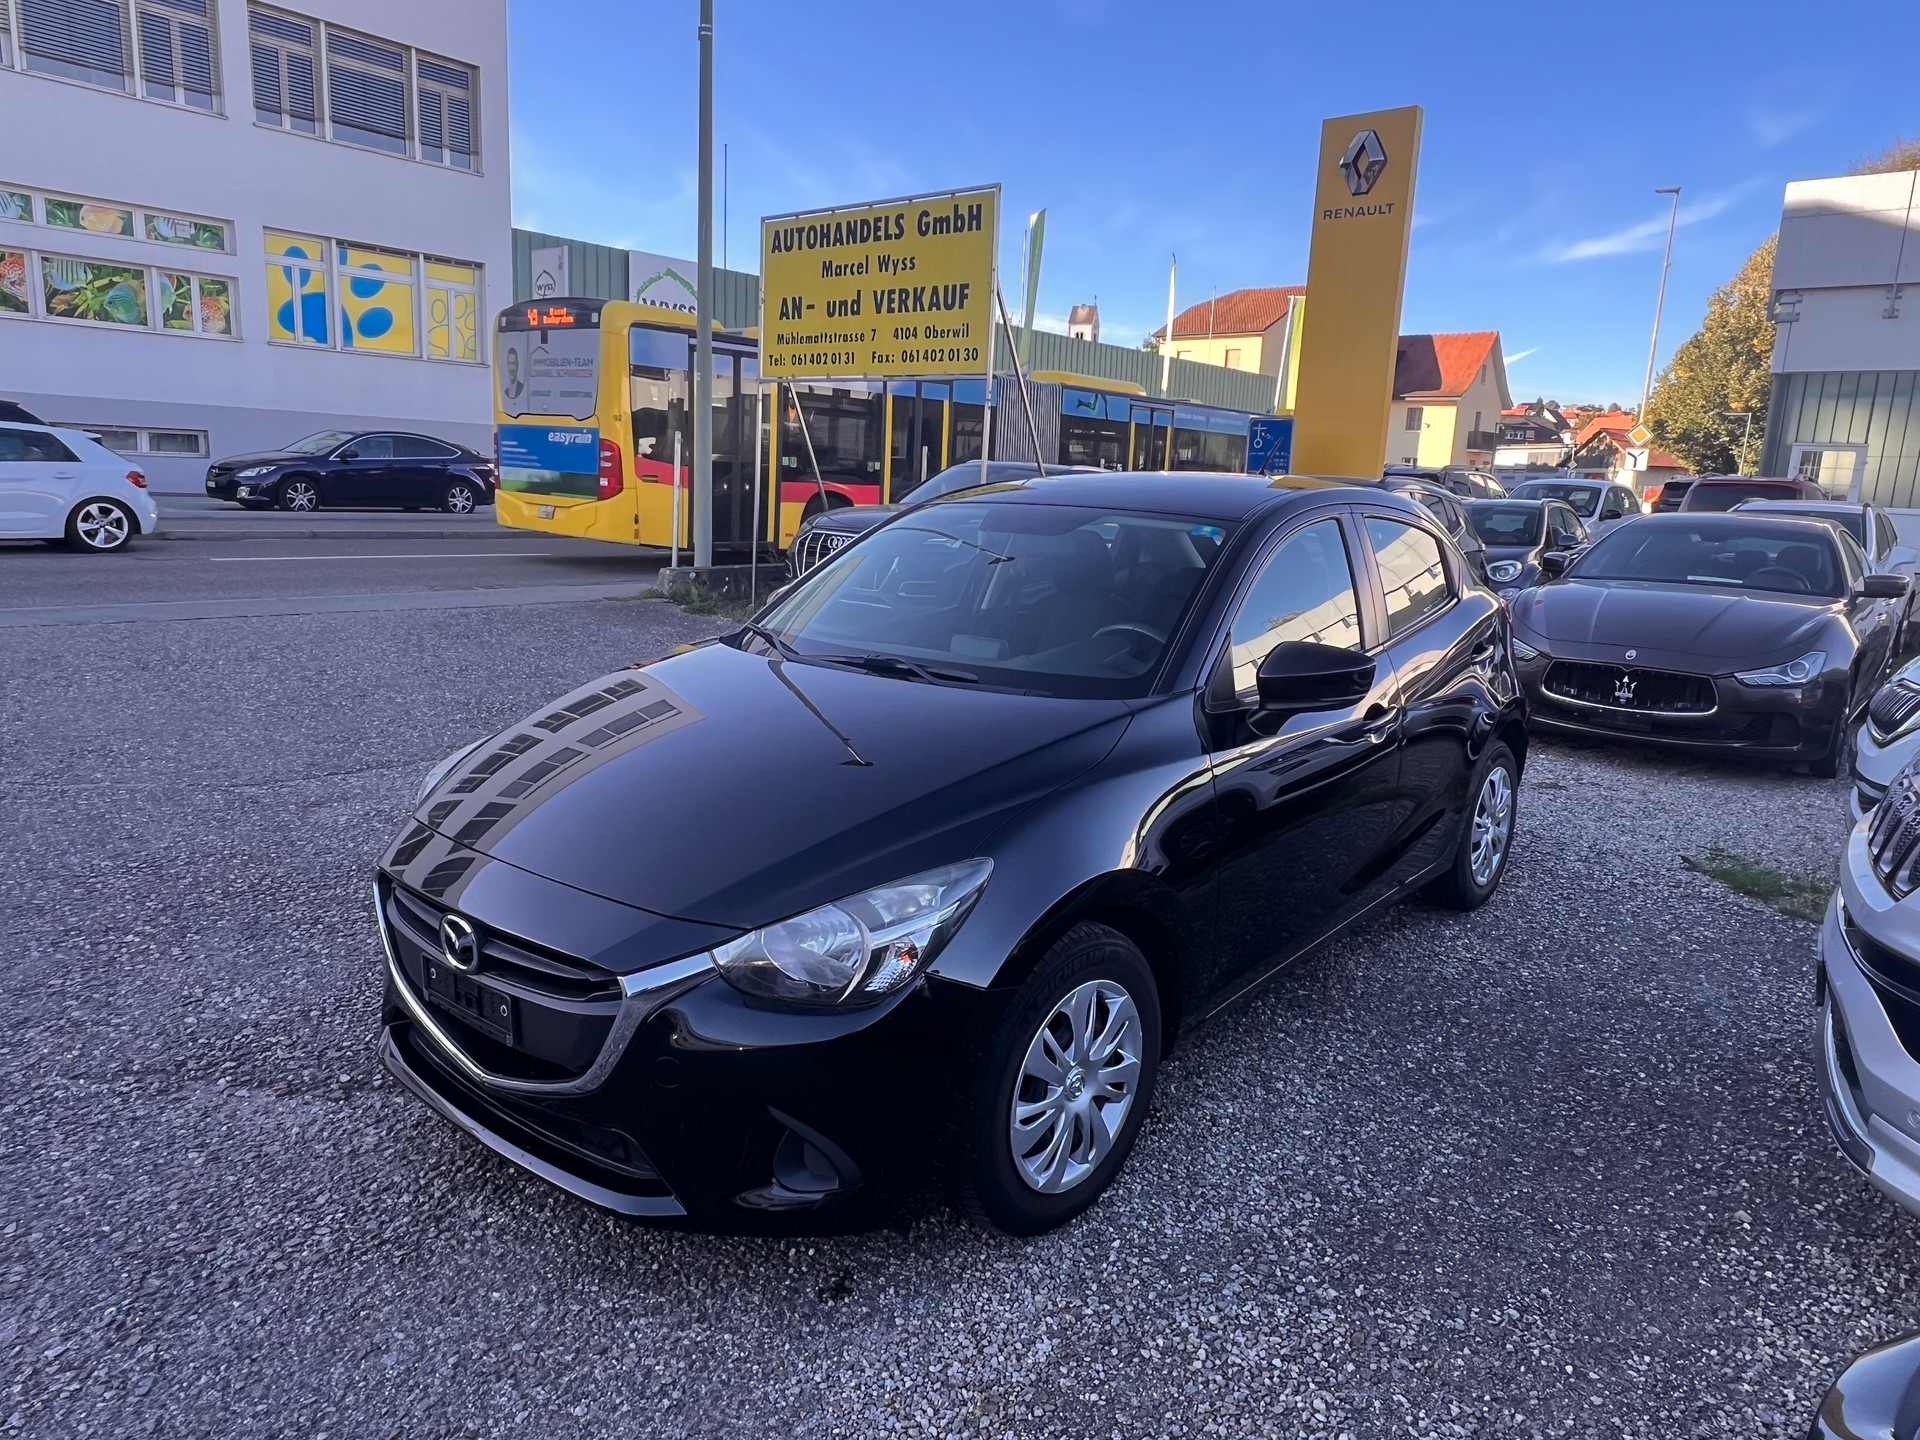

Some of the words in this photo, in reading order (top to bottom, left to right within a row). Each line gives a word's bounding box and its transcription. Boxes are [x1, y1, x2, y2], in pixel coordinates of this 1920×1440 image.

[1323, 203, 1395, 220] RENAULT
[771, 213, 905, 254] AUTOHANDELS
[917, 203, 983, 237] GmbH
[821, 254, 869, 278] Marcel
[877, 253, 916, 276] Wyss
[826, 289, 862, 318] und
[872, 283, 970, 315] VERKAUF
[776, 331, 866, 346] Mühlemattstrasse
[871, 329, 877, 342] 7
[893, 326, 918, 341] 4104
[924, 323, 970, 340] Oberwil
[768, 353, 786, 367] Tel:
[871, 350, 895, 364] Fax:
[547, 429, 592, 445] easyrain
